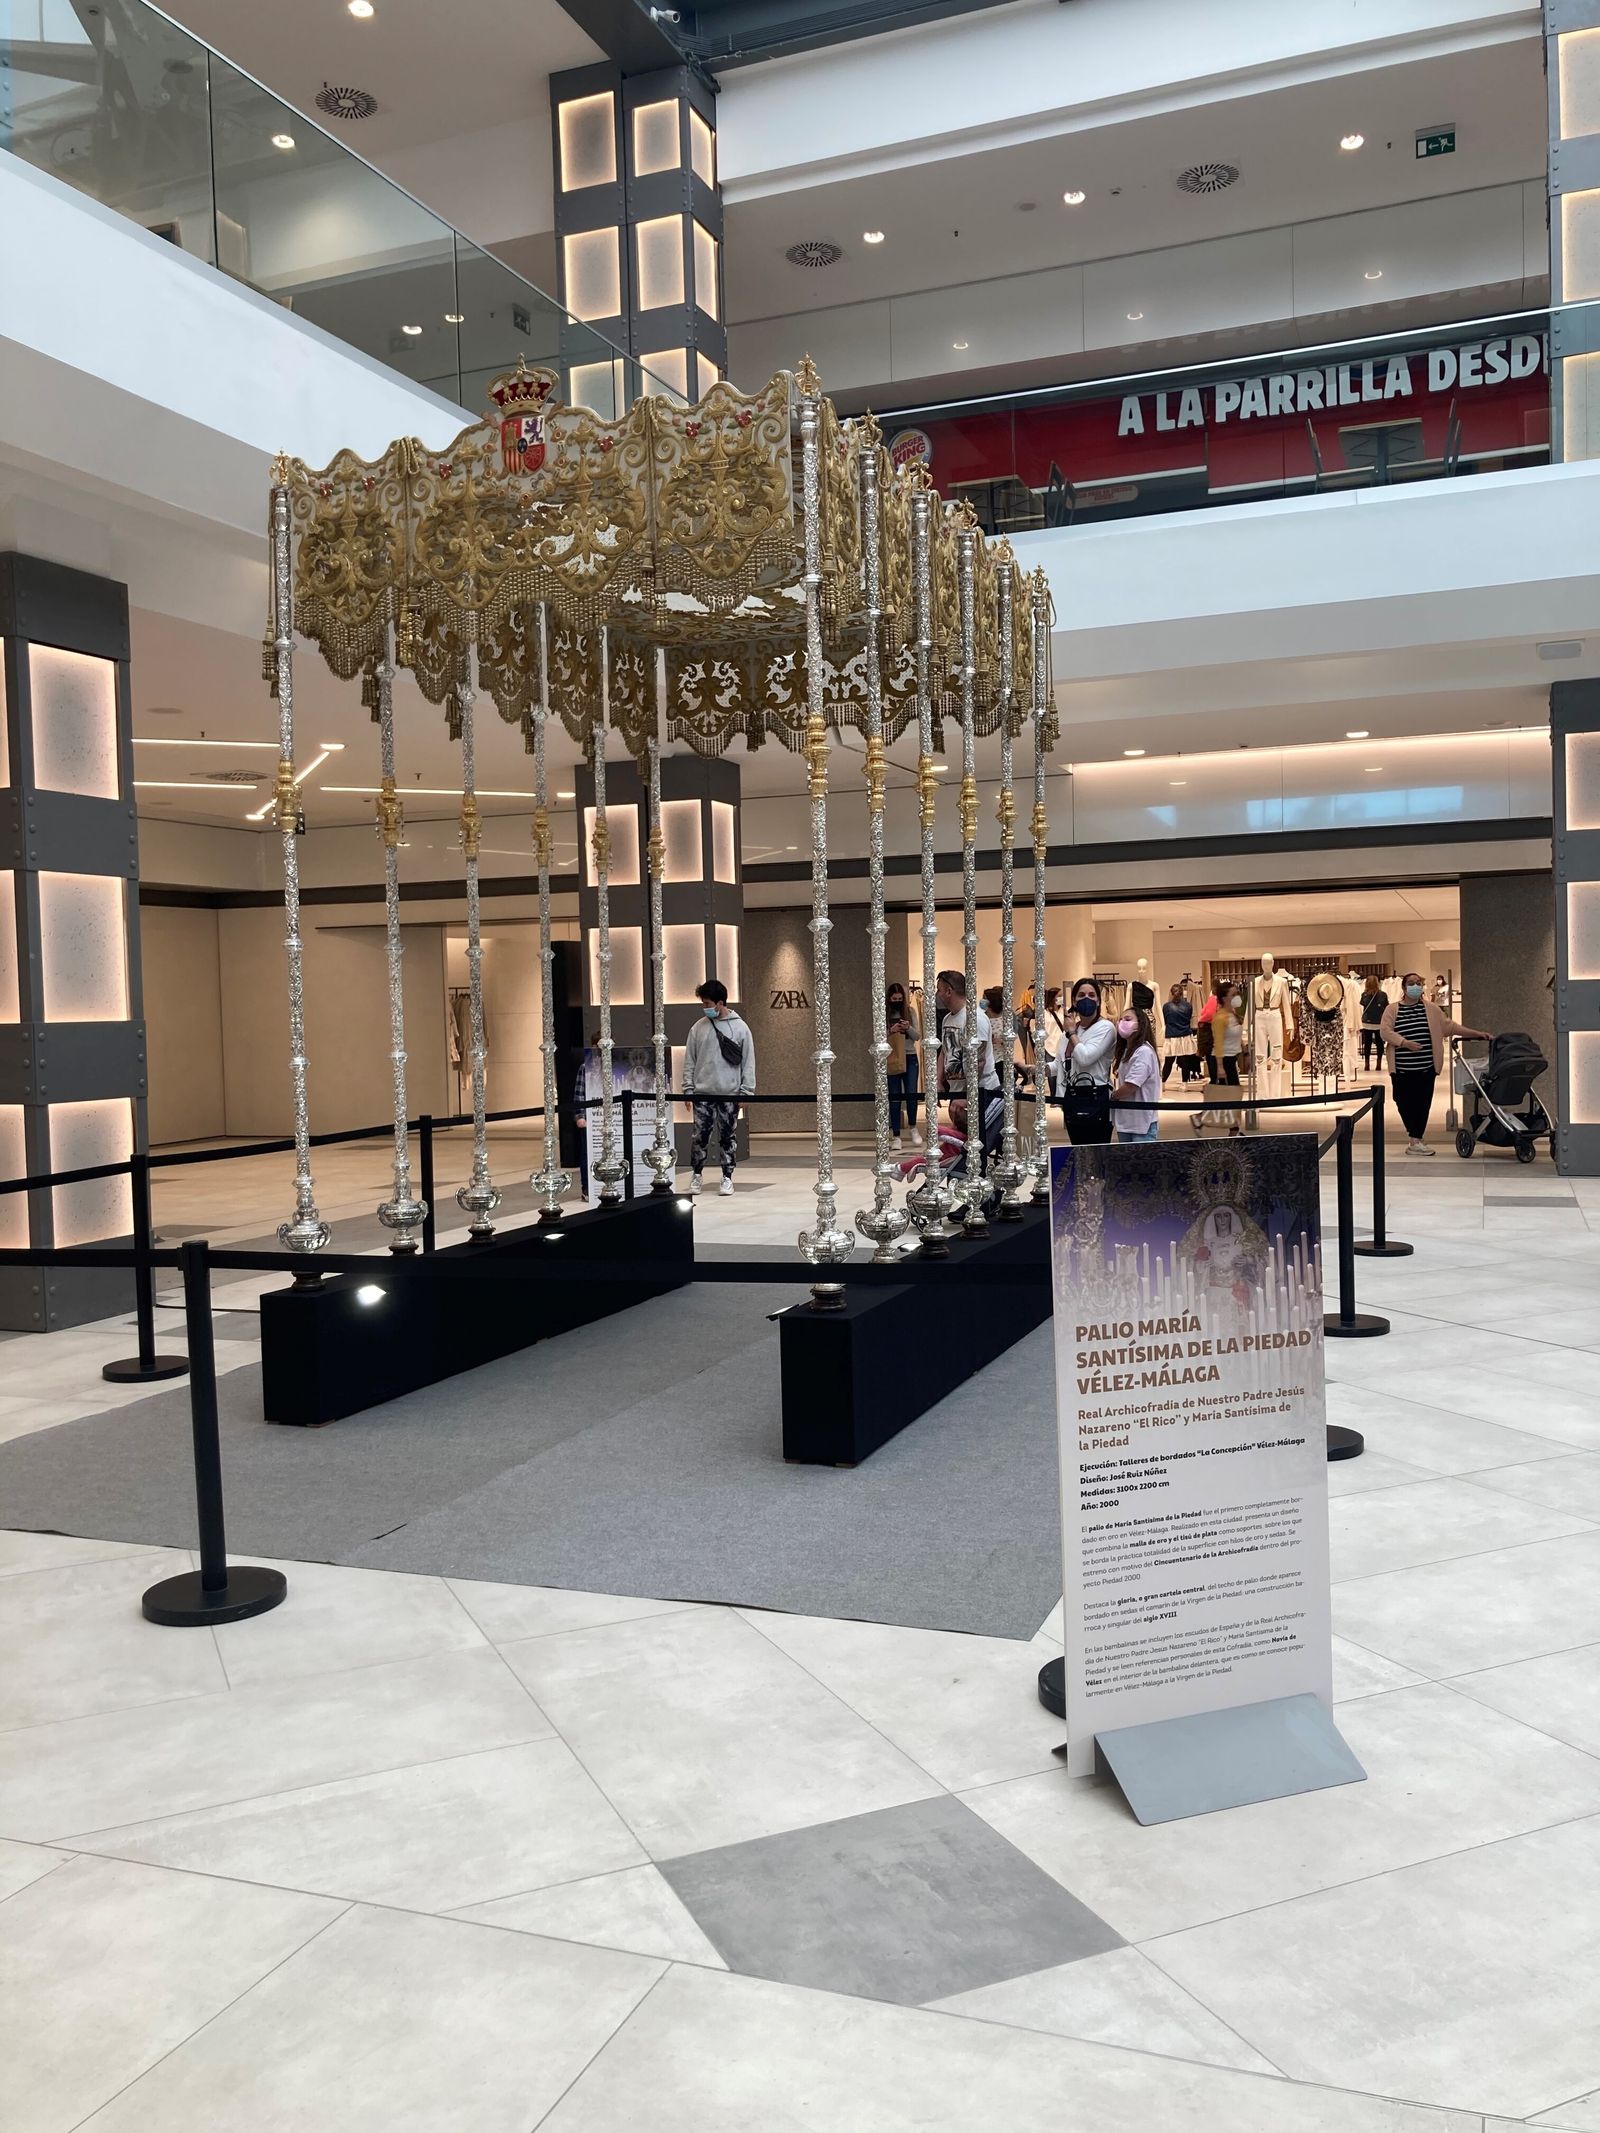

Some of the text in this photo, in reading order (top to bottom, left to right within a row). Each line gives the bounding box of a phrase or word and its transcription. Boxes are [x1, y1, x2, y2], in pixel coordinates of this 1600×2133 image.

[1118, 396, 1144, 436] A
[1156, 388, 1205, 432] LA
[1215, 355, 1413, 423] PARRILLA
[892, 435, 924, 456] BURGER
[893, 443, 926, 467] KING
[770, 990, 811, 1009] ZARA
[1075, 1308, 1201, 1342] PALIO MARÍA
[1075, 1330, 1311, 1368] SANTÍSIMA DE LA PIEDAD
[1076, 1360, 1220, 1394] VÉLEZ-MÁLAGA
[1077, 1385, 1304, 1420] Real Archicofradía de Nuestro Padre Jesús
[1078, 1402, 1291, 1435] Nazareno “El Rico” y María Santísima de
[1078, 1434, 1129, 1450] la Piedad
[1079, 1437, 1305, 1472] Ejecución: Talleres de bordados “La Concepción” Vélez-Málaga
[1079, 1466, 1167, 1484] Diseño: José Ruiz Núñez
[1080, 1486, 1115, 1497] Medidas:
[1116, 1483, 1138, 1492] 3100x
[1138, 1480, 1157, 1490] 2200
[1080, 1498, 1119, 1510] Año: 2000
[1088, 1524, 1104, 1532] palio
[1133, 1516, 1164, 1525] Santísima
[1181, 1510, 1201, 1518] Piedad
[1202, 1530, 1216, 1538] plata
[1154, 1553, 1201, 1565] Cincuentenario
[1159, 1589, 1181, 1597] cartela
